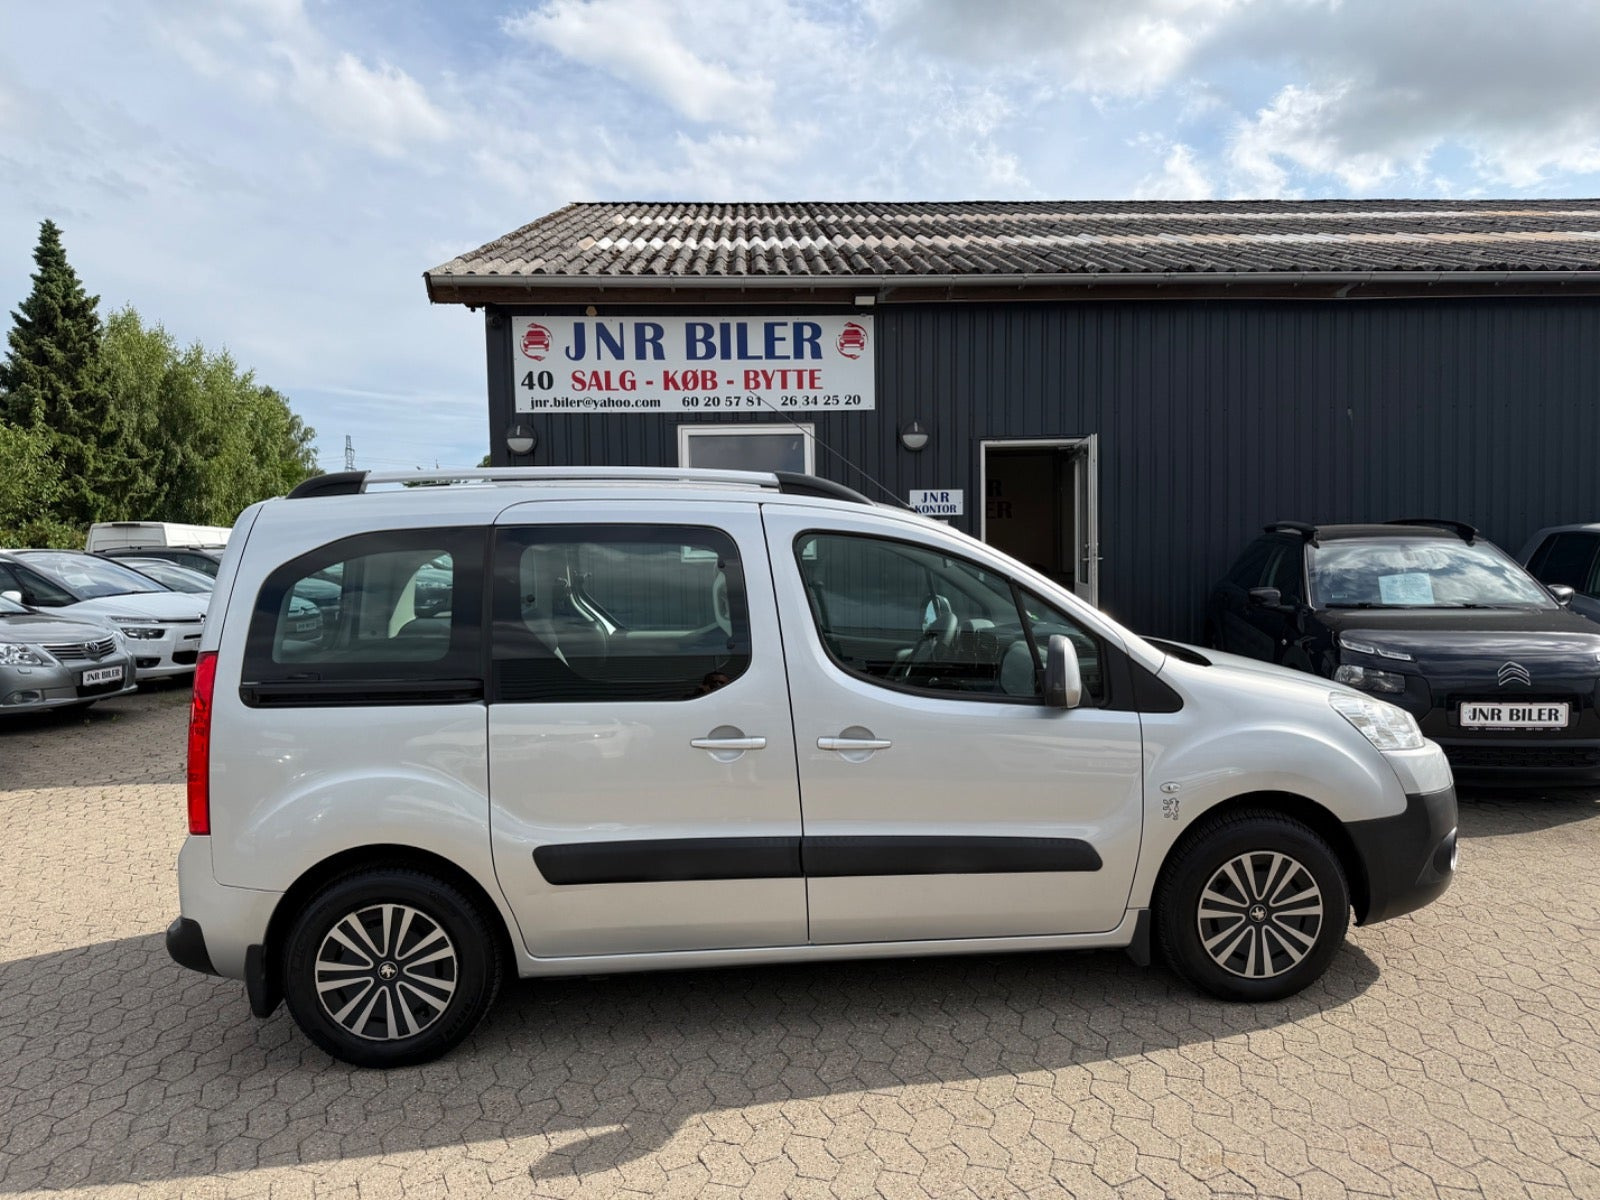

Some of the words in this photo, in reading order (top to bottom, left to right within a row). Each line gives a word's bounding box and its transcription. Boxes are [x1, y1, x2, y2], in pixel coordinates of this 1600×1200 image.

[564, 321, 666, 361] JNR
[685, 321, 823, 361] BILER
[520, 370, 554, 391] 40
[571, 369, 637, 392] SALG
[662, 368, 718, 392] KØB
[743, 368, 824, 390] BYTTE
[530, 397, 661, 410] jnr.biler@yahoo.com
[682, 396, 699, 407] 60
[703, 396, 721, 407] 20
[724, 396, 742, 407] 57
[745, 396, 762, 407] 81
[780, 395, 798, 406] 26
[802, 395, 818, 406] 34
[823, 394, 840, 406] 25
[844, 394, 861, 406] 20
[921, 491, 949, 503] JNR
[915, 504, 957, 514] KONTOR
[1468, 707, 1502, 722] JNR
[1508, 707, 1560, 722] BILER
